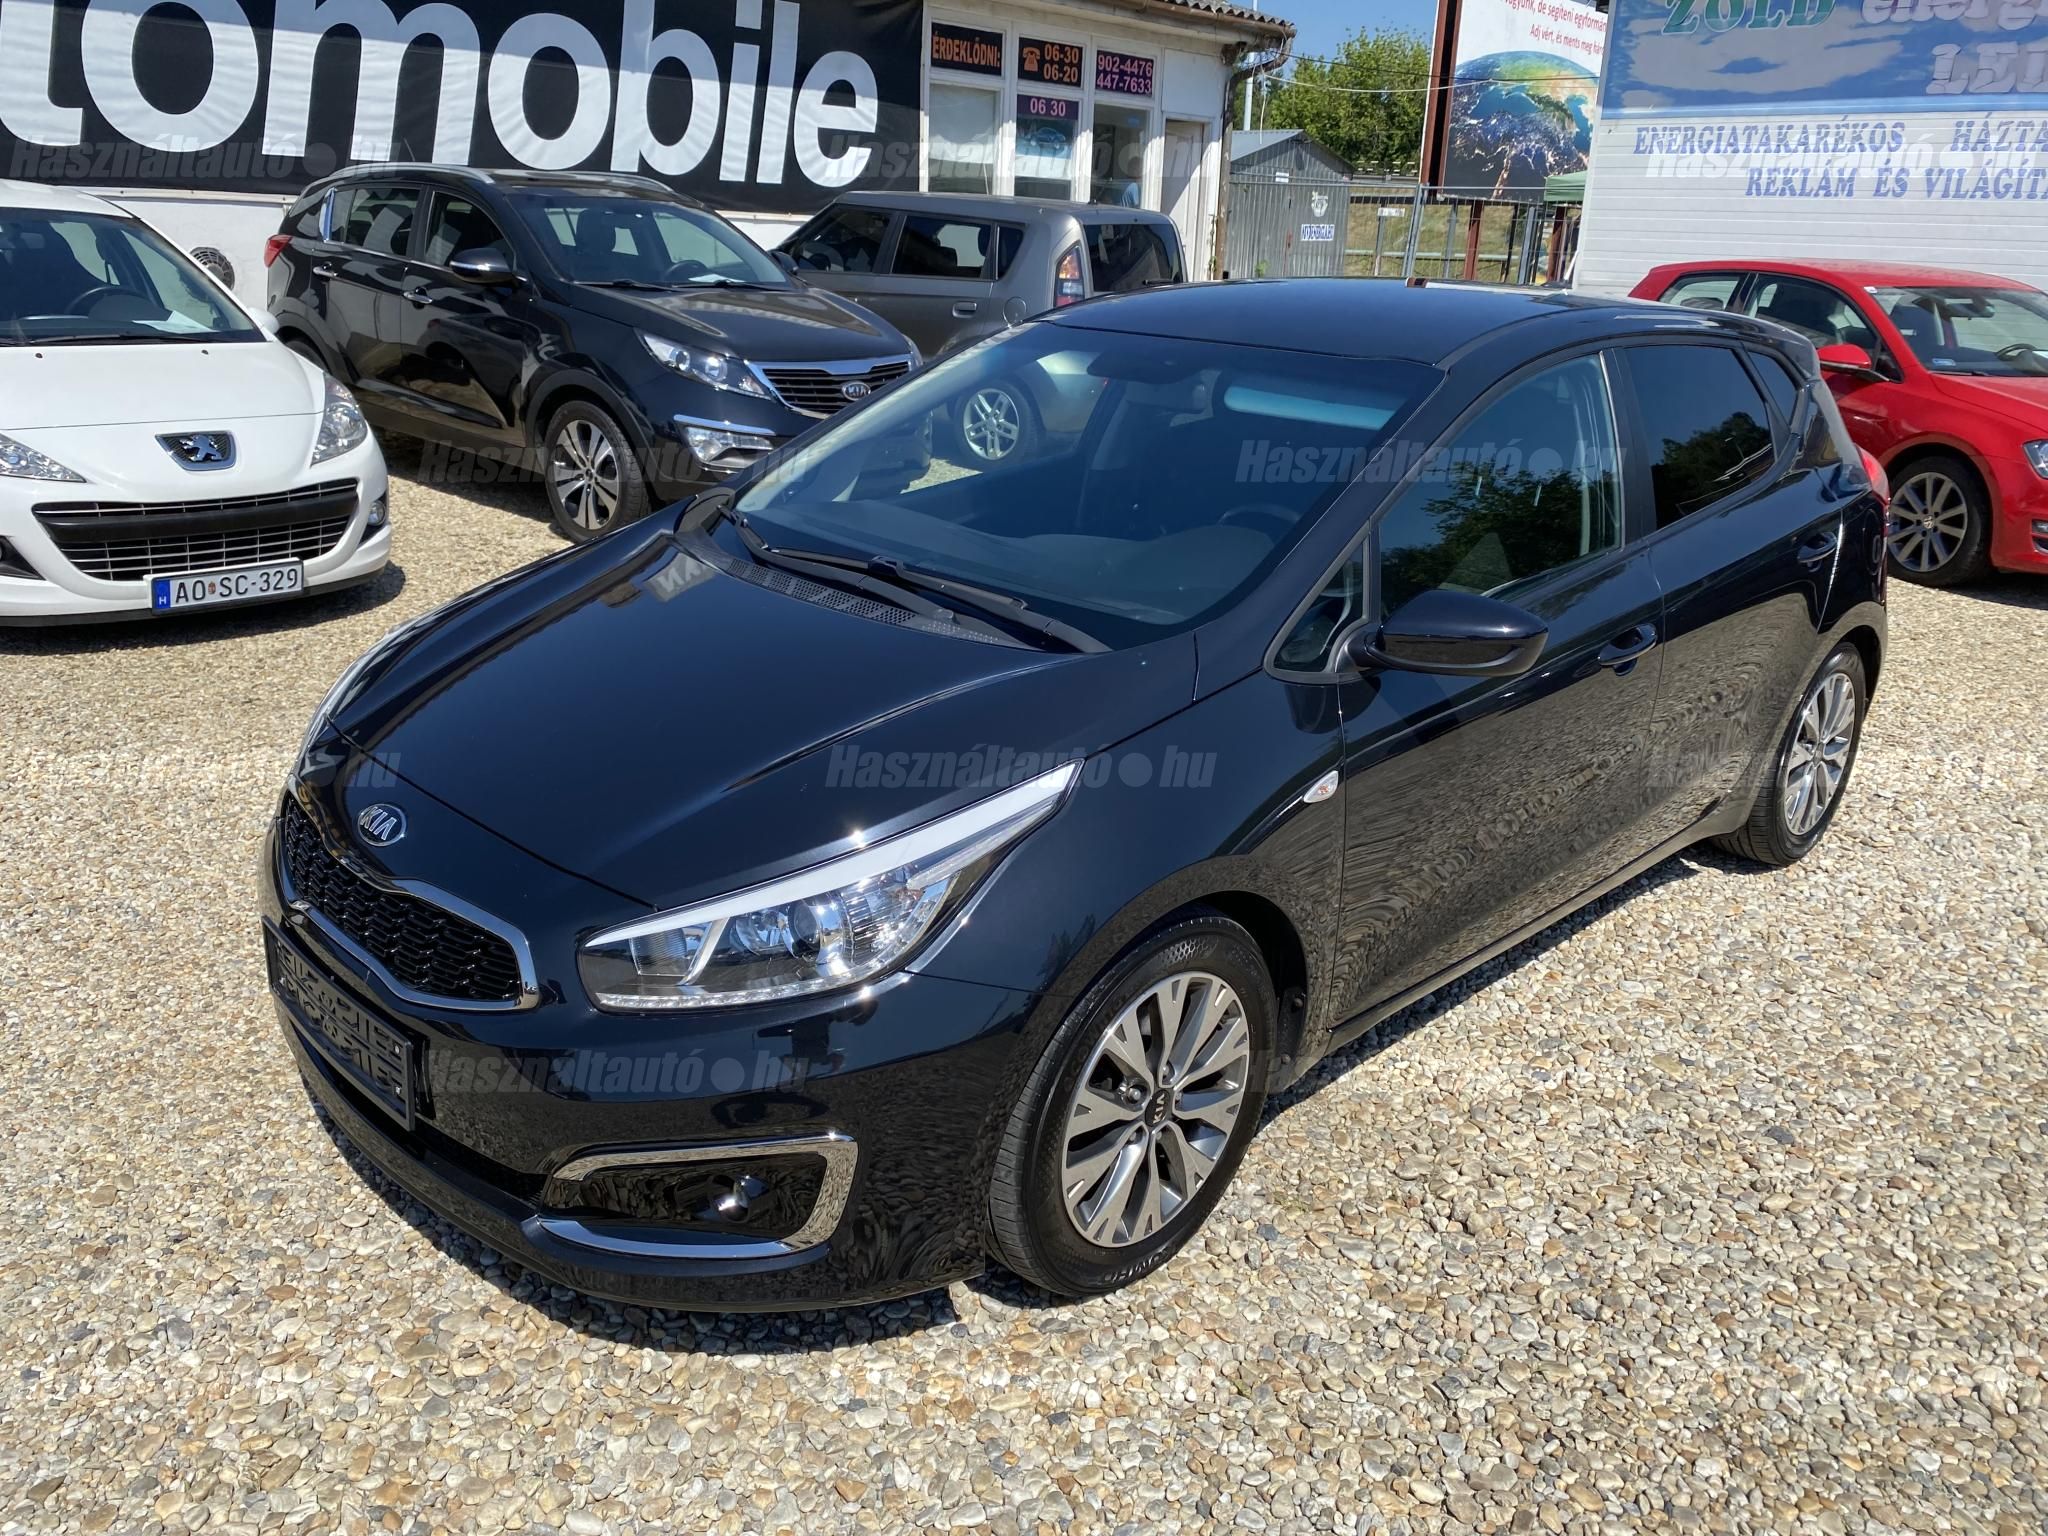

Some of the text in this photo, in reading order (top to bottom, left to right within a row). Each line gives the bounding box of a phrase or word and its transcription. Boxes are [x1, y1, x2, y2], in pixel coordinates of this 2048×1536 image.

[1044, 43, 1079, 64] 06-30
[1043, 64, 1078, 83] 06-20
[1097, 54, 1153, 76] 902-4476
[1096, 73, 1152, 94] 447-7633
[1030, 98, 1066, 117] 06 30
[1633, 115, 1905, 154] ENERGIATAKARÉKOS
[1745, 158, 2048, 199] REKLÁM ÉS VILÁGÍT
[175, 568, 298, 604] AO SC-329
[159, 595, 167, 605] H
[359, 805, 398, 841] KIA
